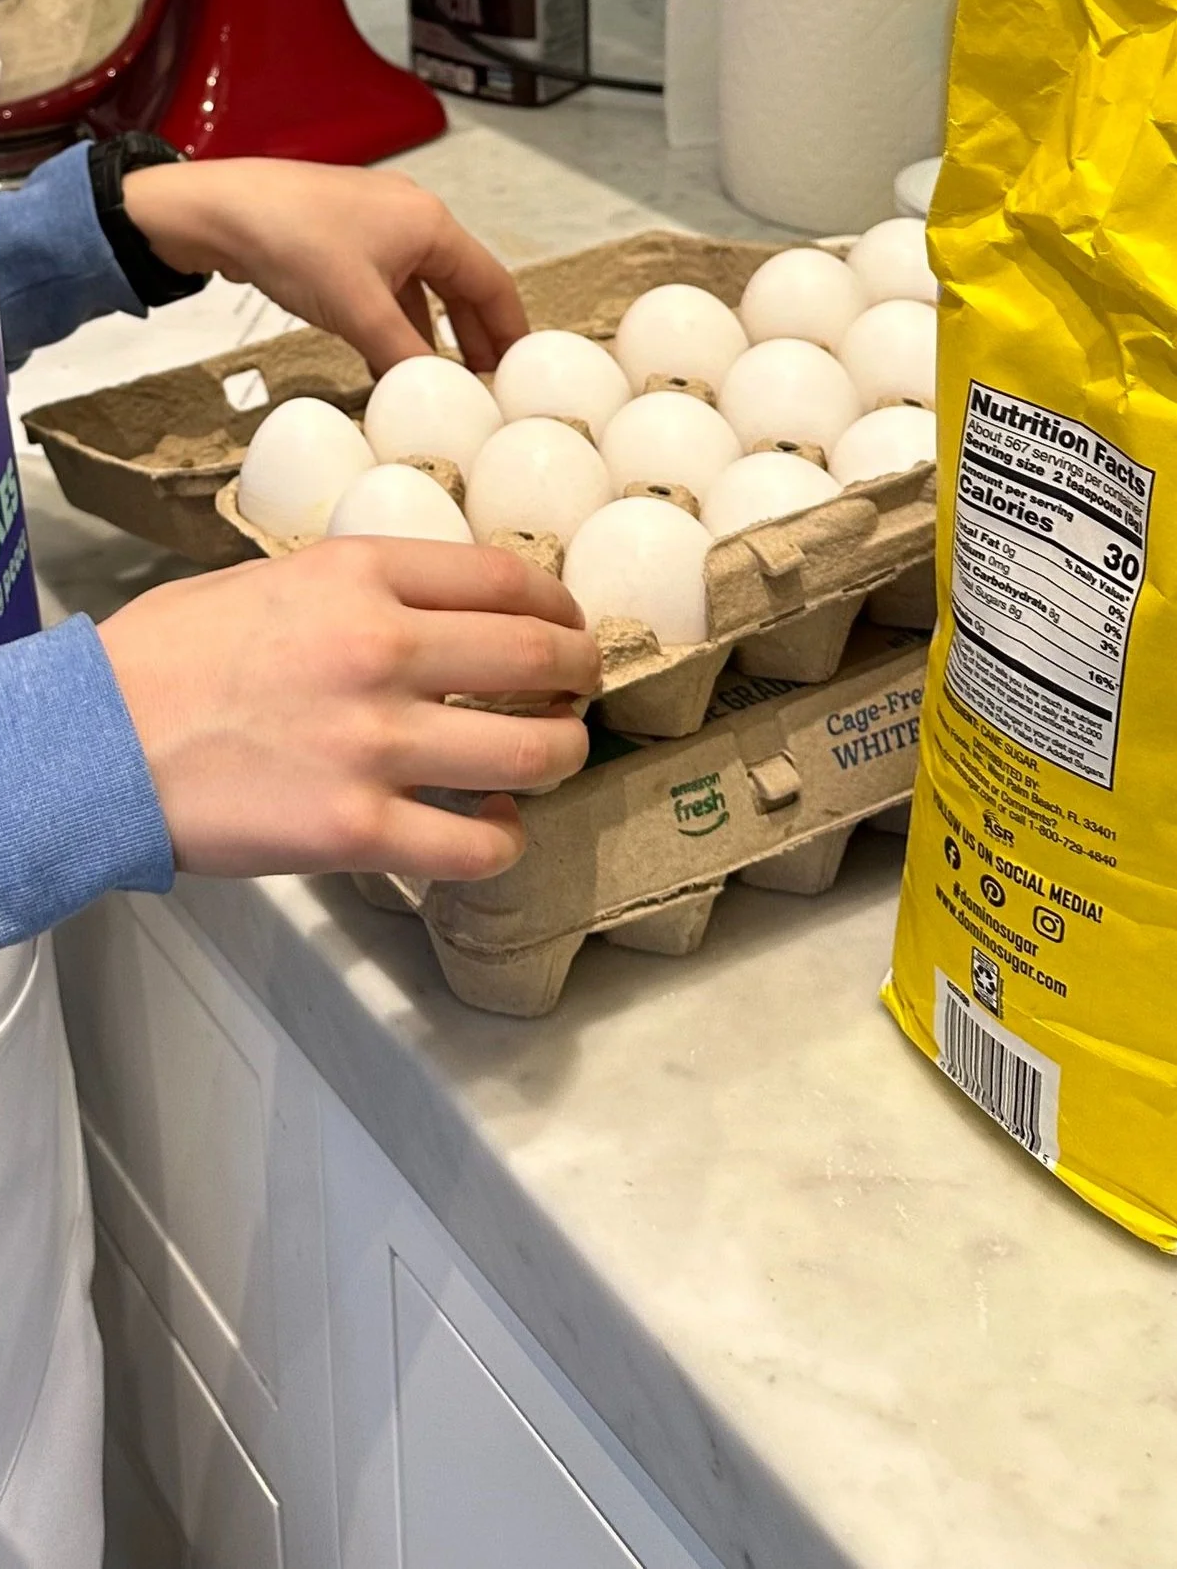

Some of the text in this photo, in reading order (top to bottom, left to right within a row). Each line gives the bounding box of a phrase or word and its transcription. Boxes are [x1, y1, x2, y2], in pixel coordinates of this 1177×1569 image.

[967, 419, 1144, 518] About 567 servings per container
[971, 388, 1146, 498] Nutrition Facts
[961, 461, 1075, 523] Amount per serving
[965, 432, 1143, 536] Serving size 2 teaspoons (8g)
[959, 474, 1140, 582] Calories 30
[956, 516, 1126, 623] Total Fat 0g 0%
[987, 554, 1011, 575] 0mg
[1103, 622, 1123, 640] 0%
[1064, 557, 1073, 570] %
[1074, 565, 1098, 586] Daily
[972, 566, 1048, 613] Carbohydrate
[1048, 607, 1061, 624] 8g
[1099, 639, 1120, 658] 3%
[974, 585, 1008, 611] Sugars
[1008, 603, 1023, 620] 8g
[974, 618, 986, 636] 0g
[827, 685, 926, 737] Cage-Fre
[1008, 674, 1023, 690] you
[1023, 682, 1040, 699] how
[1040, 691, 1063, 712] much
[1070, 708, 1104, 730] nutrient
[1033, 707, 1066, 735] nutrition
[1040, 702, 1059, 720] daily
[973, 735, 1040, 793] DISTRIBUTED BY:
[979, 724, 1005, 750] CANE
[1004, 742, 1041, 774] SUGAR.
[1011, 721, 1035, 745] Value
[1045, 745, 1074, 765] Added
[1073, 757, 1107, 781] Sugars.
[1032, 728, 1052, 743] your
[1067, 745, 1086, 760] and
[670, 771, 721, 798] amazon
[674, 788, 726, 823] fresh
[959, 752, 990, 790] Questions
[1000, 789, 1058, 829] Comments?
[1005, 778, 1029, 800] Palm
[1031, 790, 1066, 820] Beach,
[1067, 810, 1081, 826] FL
[1082, 818, 1117, 843] 33401
[984, 820, 1015, 846] ASR
[997, 803, 1008, 815] or
[1008, 810, 1026, 826] call
[933, 788, 1104, 924] FOLLOW US ON SOCIAL MEDIA!
[935, 882, 1068, 999] www.dominosugar.com
[953, 880, 1039, 958] #dominosugar
